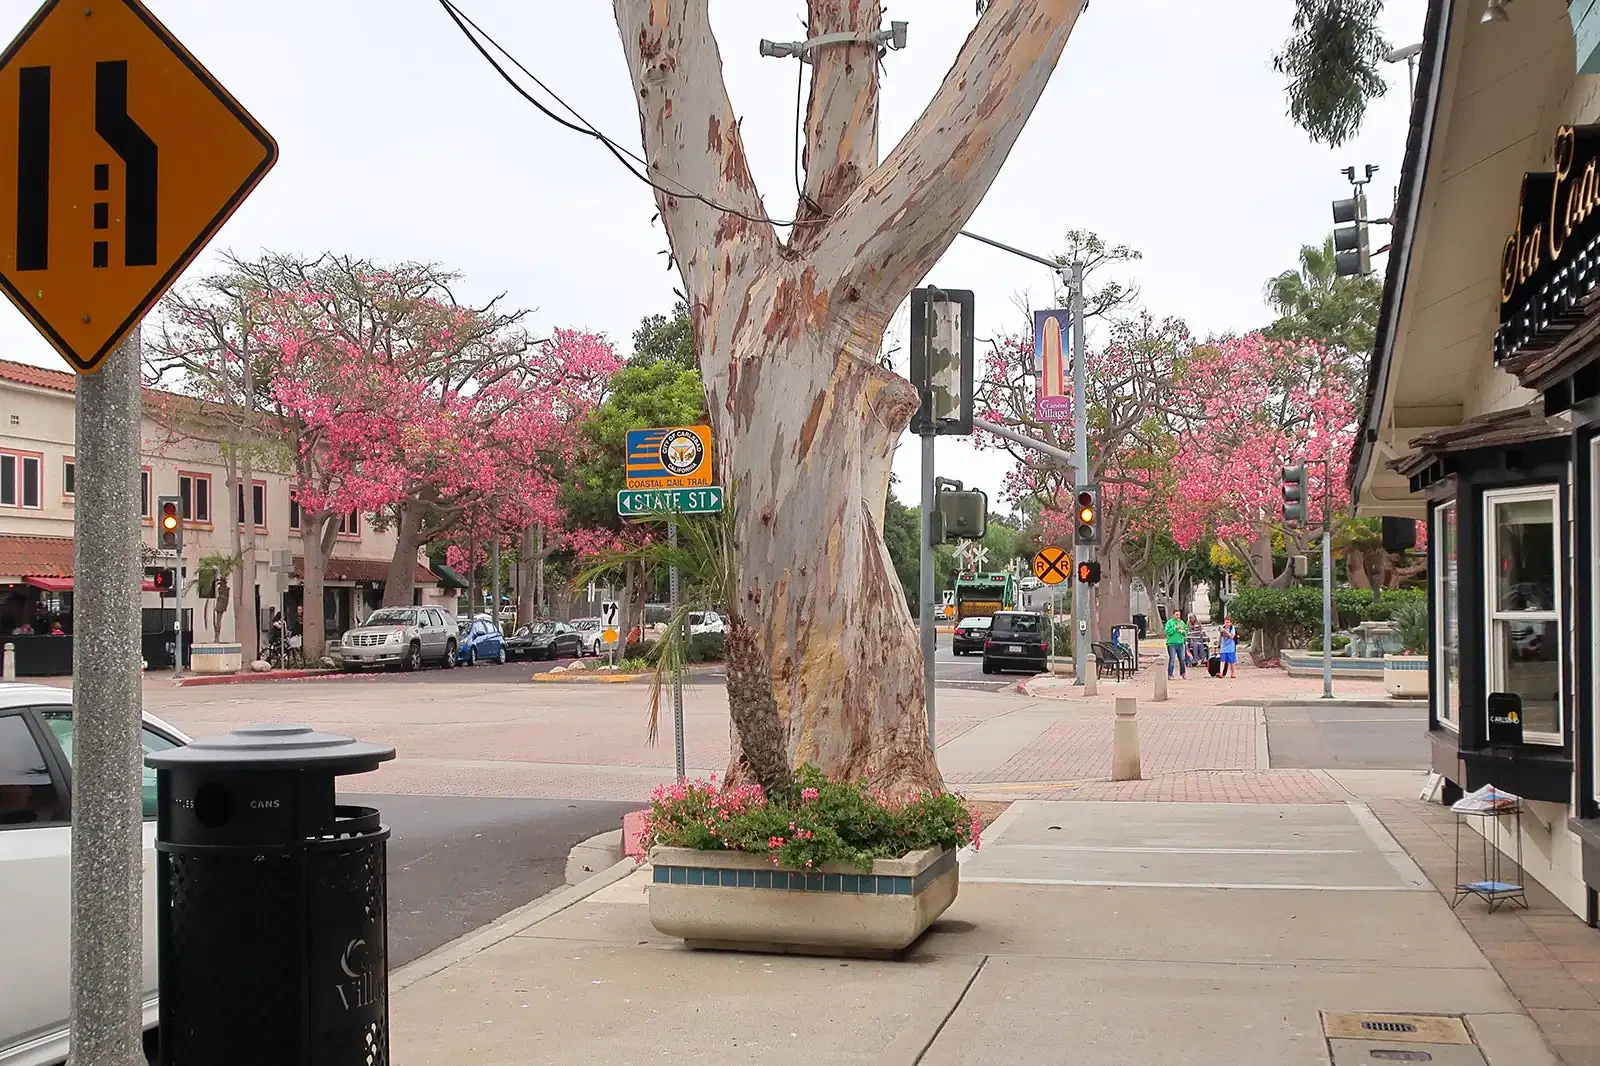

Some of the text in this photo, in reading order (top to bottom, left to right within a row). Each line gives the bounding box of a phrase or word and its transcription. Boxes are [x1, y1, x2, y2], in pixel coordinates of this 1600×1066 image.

[1039, 408, 1069, 420] Village
[662, 439, 670, 454] CITY
[676, 431, 702, 453] CARLSBAD
[667, 462, 697, 474] CALIFORNIA
[628, 479, 663, 489] COASTAL
[688, 477, 709, 486] TRAIL
[634, 491, 707, 510] STATE ST
[250, 799, 280, 809] CANS
